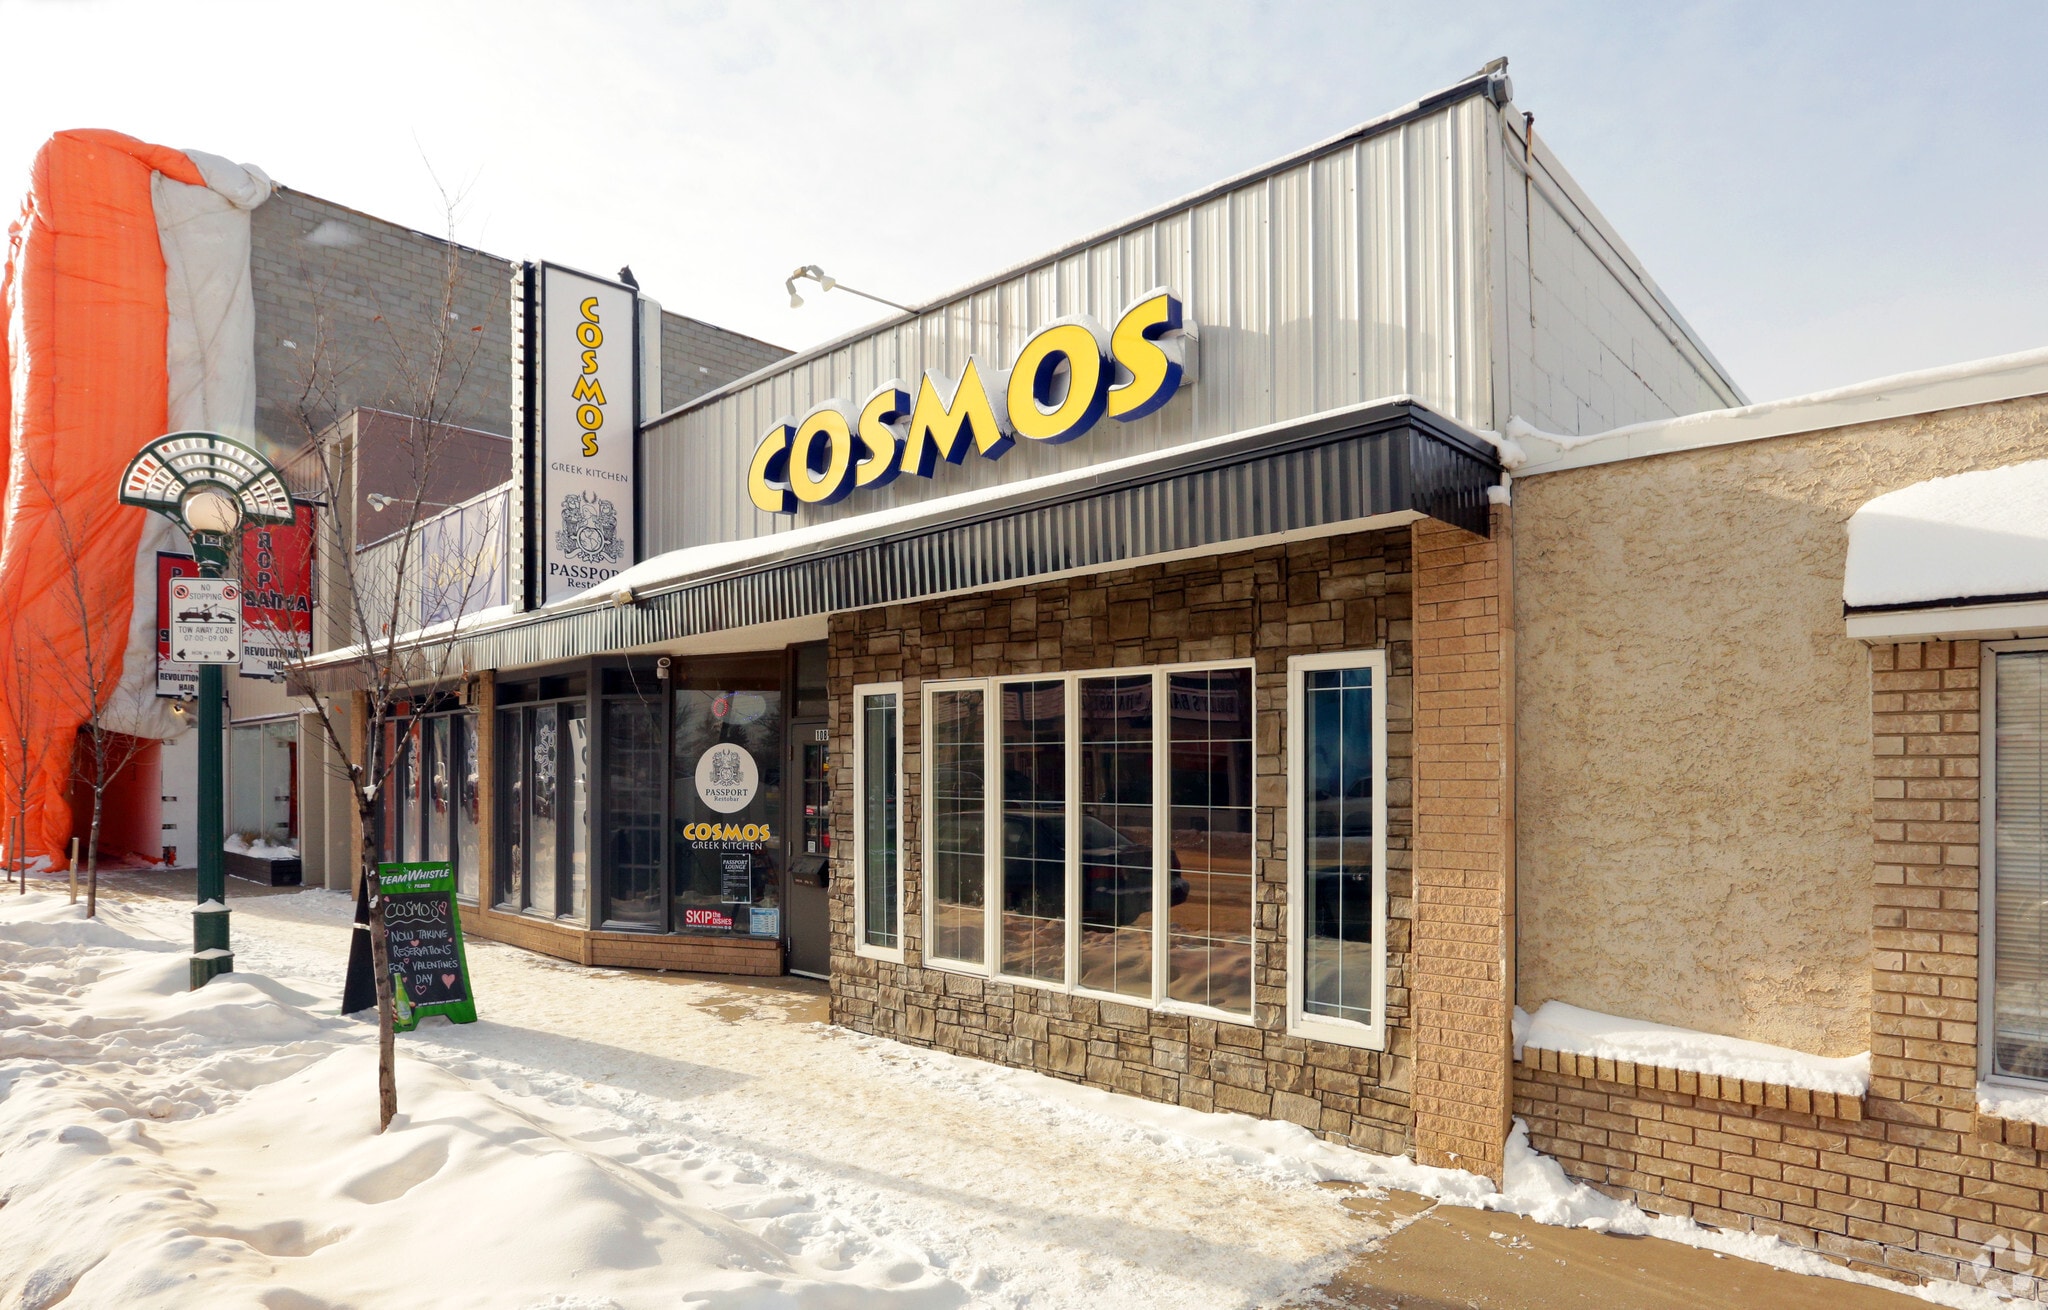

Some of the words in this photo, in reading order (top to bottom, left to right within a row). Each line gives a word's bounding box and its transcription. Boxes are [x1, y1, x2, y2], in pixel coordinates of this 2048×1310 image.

[572, 296, 607, 457] COSMOS
[747, 293, 1182, 515] COSMOS
[551, 462, 583, 475] GREEK
[585, 468, 629, 483] KITCHEN
[549, 562, 624, 581] PASSPOR
[200, 583, 211, 592] NO
[567, 577, 600, 588] Resto
[189, 592, 222, 601] STOPPING
[179, 625, 193, 634] TOW
[195, 626, 213, 634] AWAY
[215, 626, 234, 635] ZONE
[244, 646, 309, 658] REVOLUTINAY
[159, 672, 199, 682] REVOLUTION
[178, 683, 195, 692] HAIR
[705, 788, 749, 796] PASSPORT
[683, 822, 771, 842] COSMOS
[691, 841, 720, 849] GREEK
[722, 841, 763, 850] KITCHEN
[384, 900, 440, 919] COSMOS
[685, 909, 713, 924] SKIP
[390, 930, 414, 943] NOW
[417, 928, 449, 940] TAKING
[393, 944, 452, 958] RESERVATIONS
[388, 961, 407, 974] FOR
[412, 957, 458, 972] VALENTINE'S
[415, 973, 433, 987] DAY
